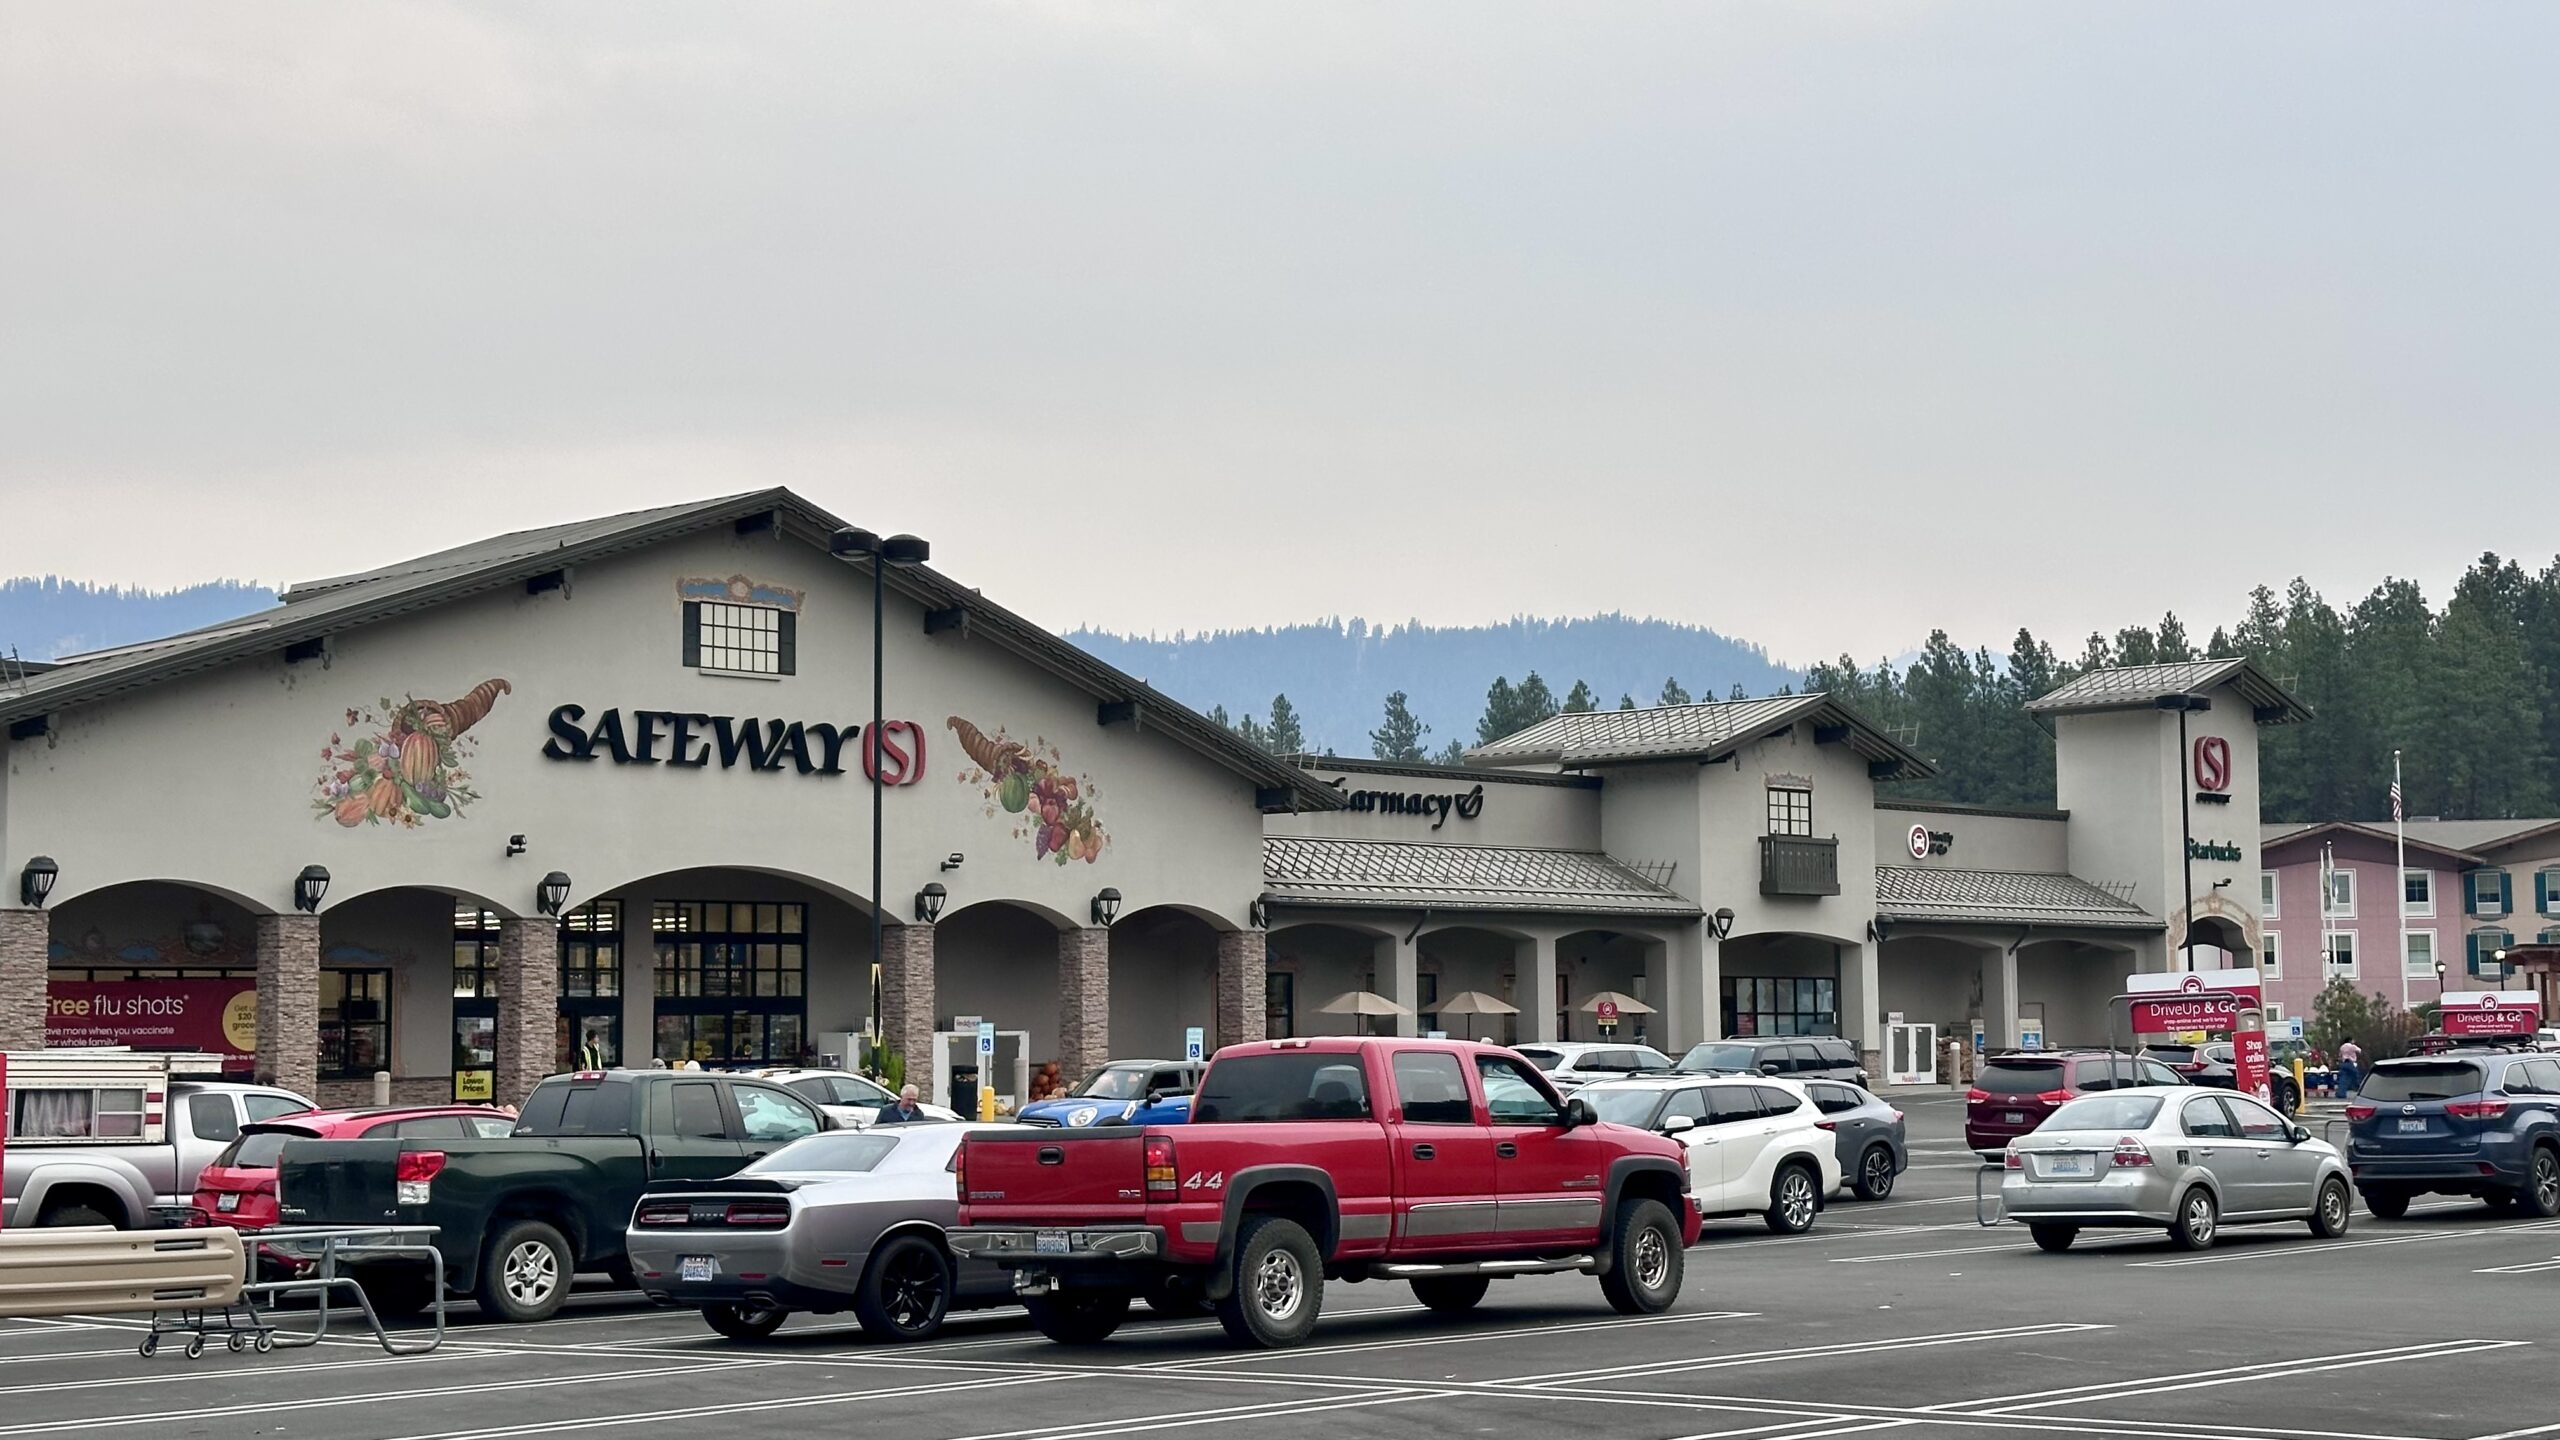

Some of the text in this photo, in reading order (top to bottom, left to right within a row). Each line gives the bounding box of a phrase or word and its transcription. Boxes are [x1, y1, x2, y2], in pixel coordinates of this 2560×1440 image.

[542, 704, 860, 775] SAFEWAY
[1333, 777, 1452, 830] armacy
[94, 994, 121, 1015] flu
[2150, 1002, 2201, 1017] DriveUp
[2204, 1001, 2215, 1014] &
[238, 1012, 252, 1021] $20
[2457, 1013, 2495, 1024] DriveUp
[2496, 1013, 2506, 1023] &
[63, 1027, 87, 1035] more
[88, 1027, 112, 1035] when
[114, 1027, 131, 1037] you
[131, 1026, 175, 1035] vaccinate
[61, 1038, 87, 1046] whole
[2245, 1040, 2263, 1052] Shop
[463, 1077, 485, 1085] Lower
[463, 1084, 485, 1092] Prices
